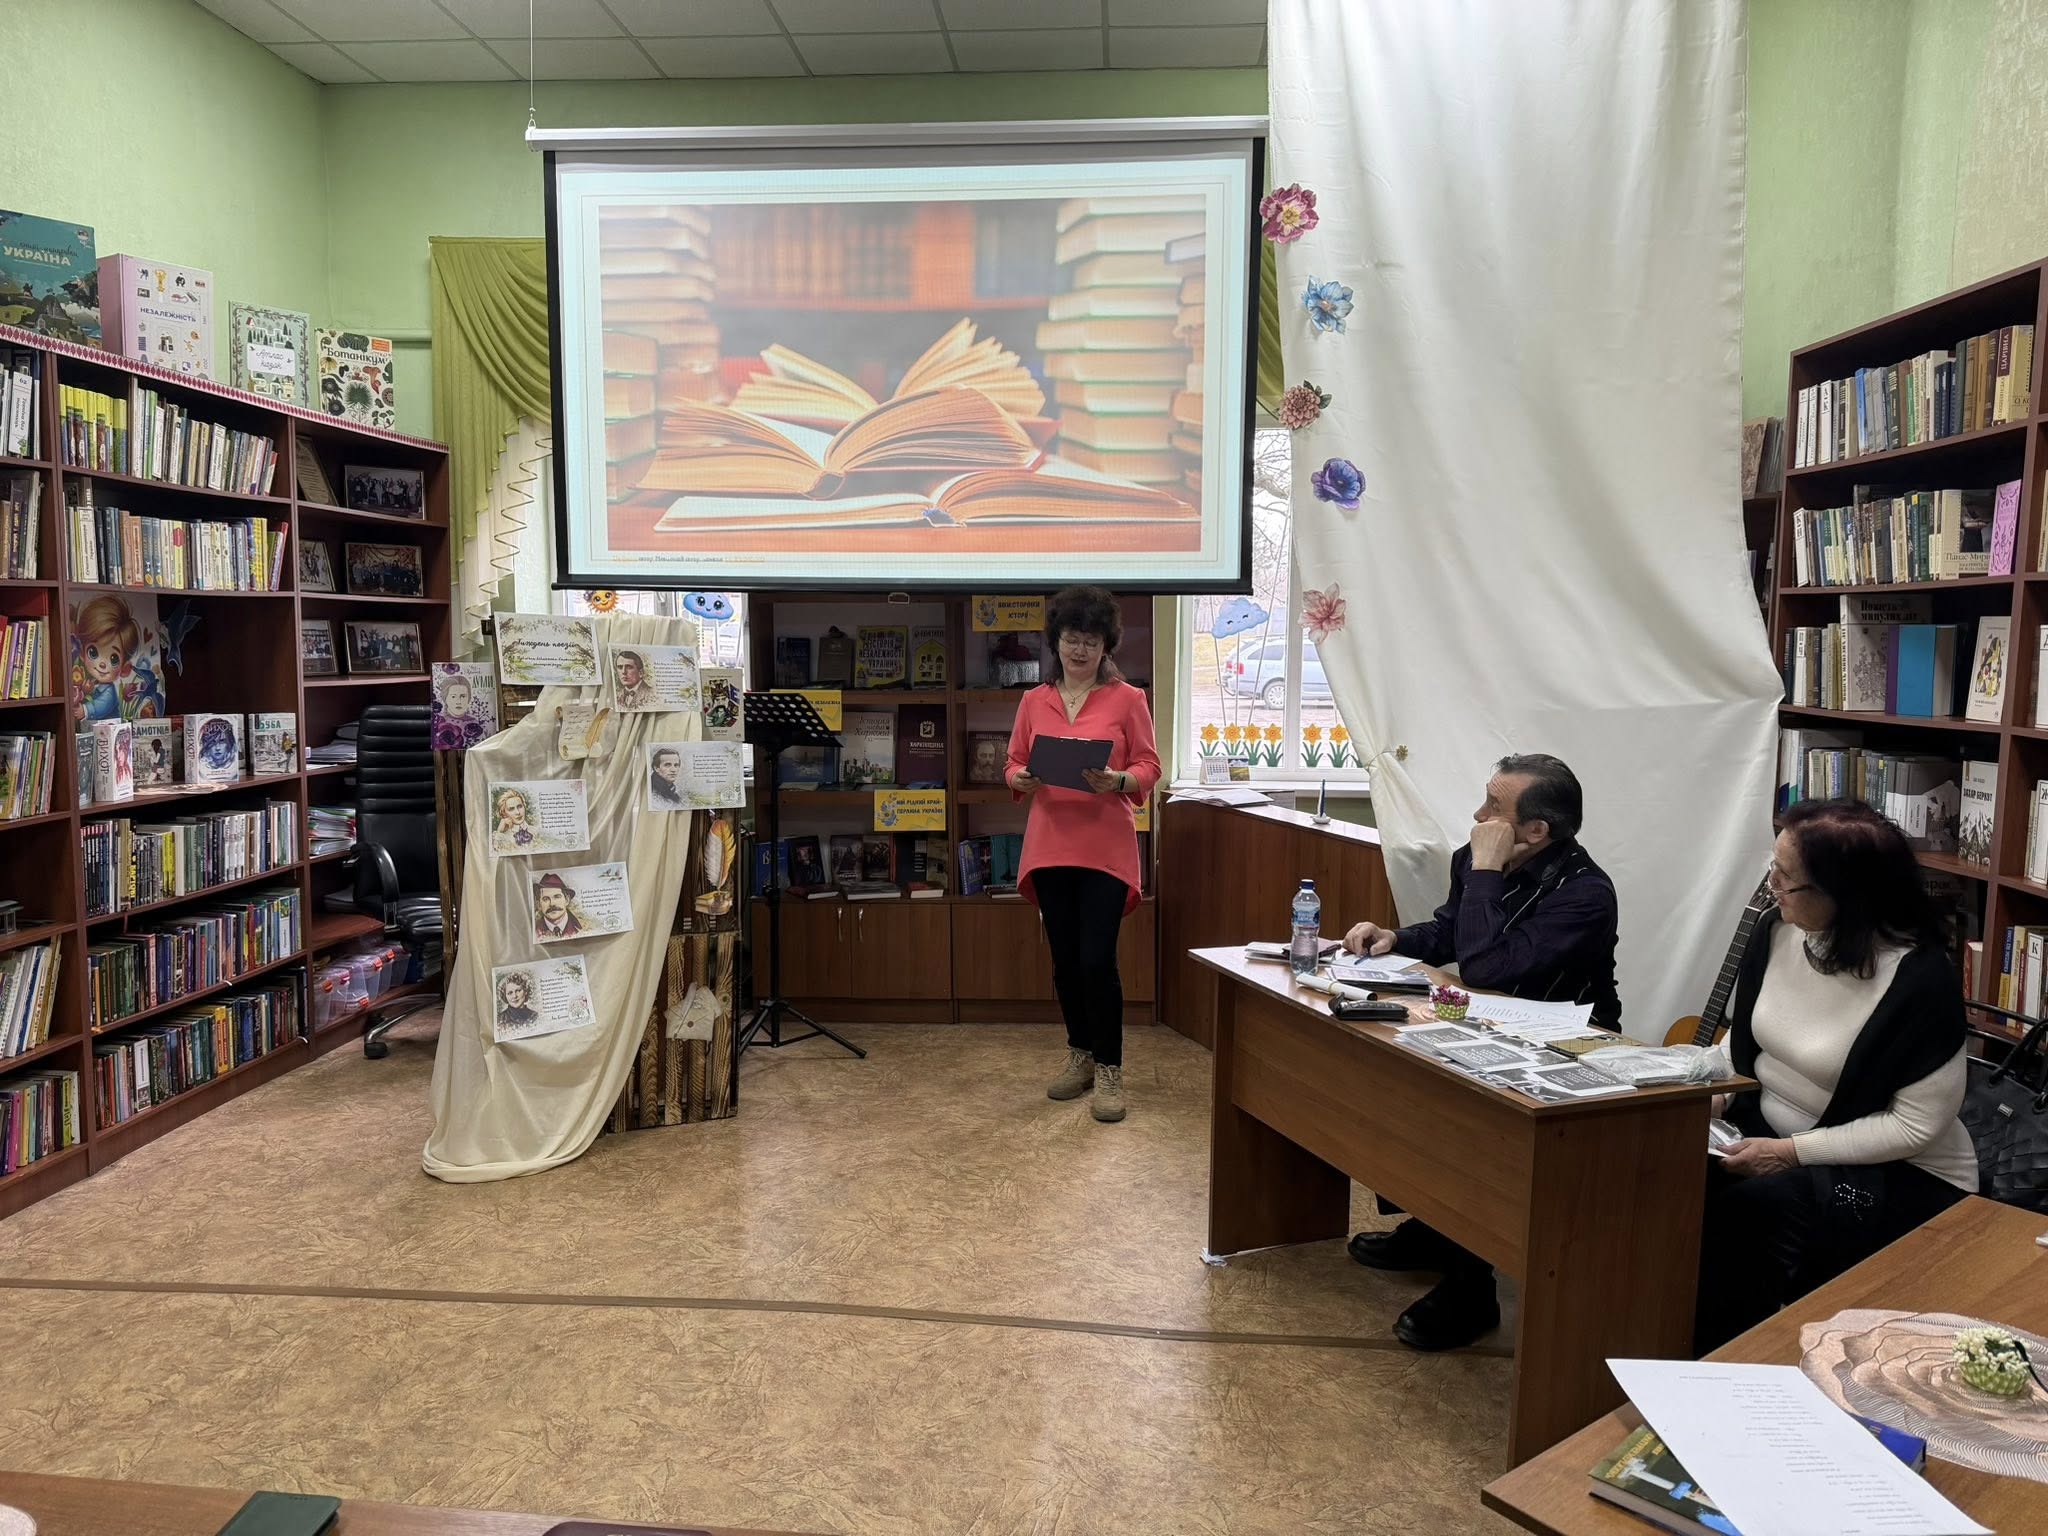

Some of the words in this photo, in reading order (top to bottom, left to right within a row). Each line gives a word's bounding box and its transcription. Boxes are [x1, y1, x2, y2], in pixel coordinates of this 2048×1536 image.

[3, 245, 71, 266] УКРАЇНА
[140, 307, 197, 323] НЕЗАЛЕЖНІСТЬ
[256, 349, 284, 361] Атлас
[327, 348, 388, 365] Ботанікум
[2001, 333, 2009, 370] ЦАРІВНА
[261, 361, 282, 370] казок
[516, 638, 551, 649] Тиждень
[186, 728, 196, 760] ВИХОР
[96, 738, 110, 774] ВИХОР
[1977, 791, 1993, 801] БЕРКУТ
